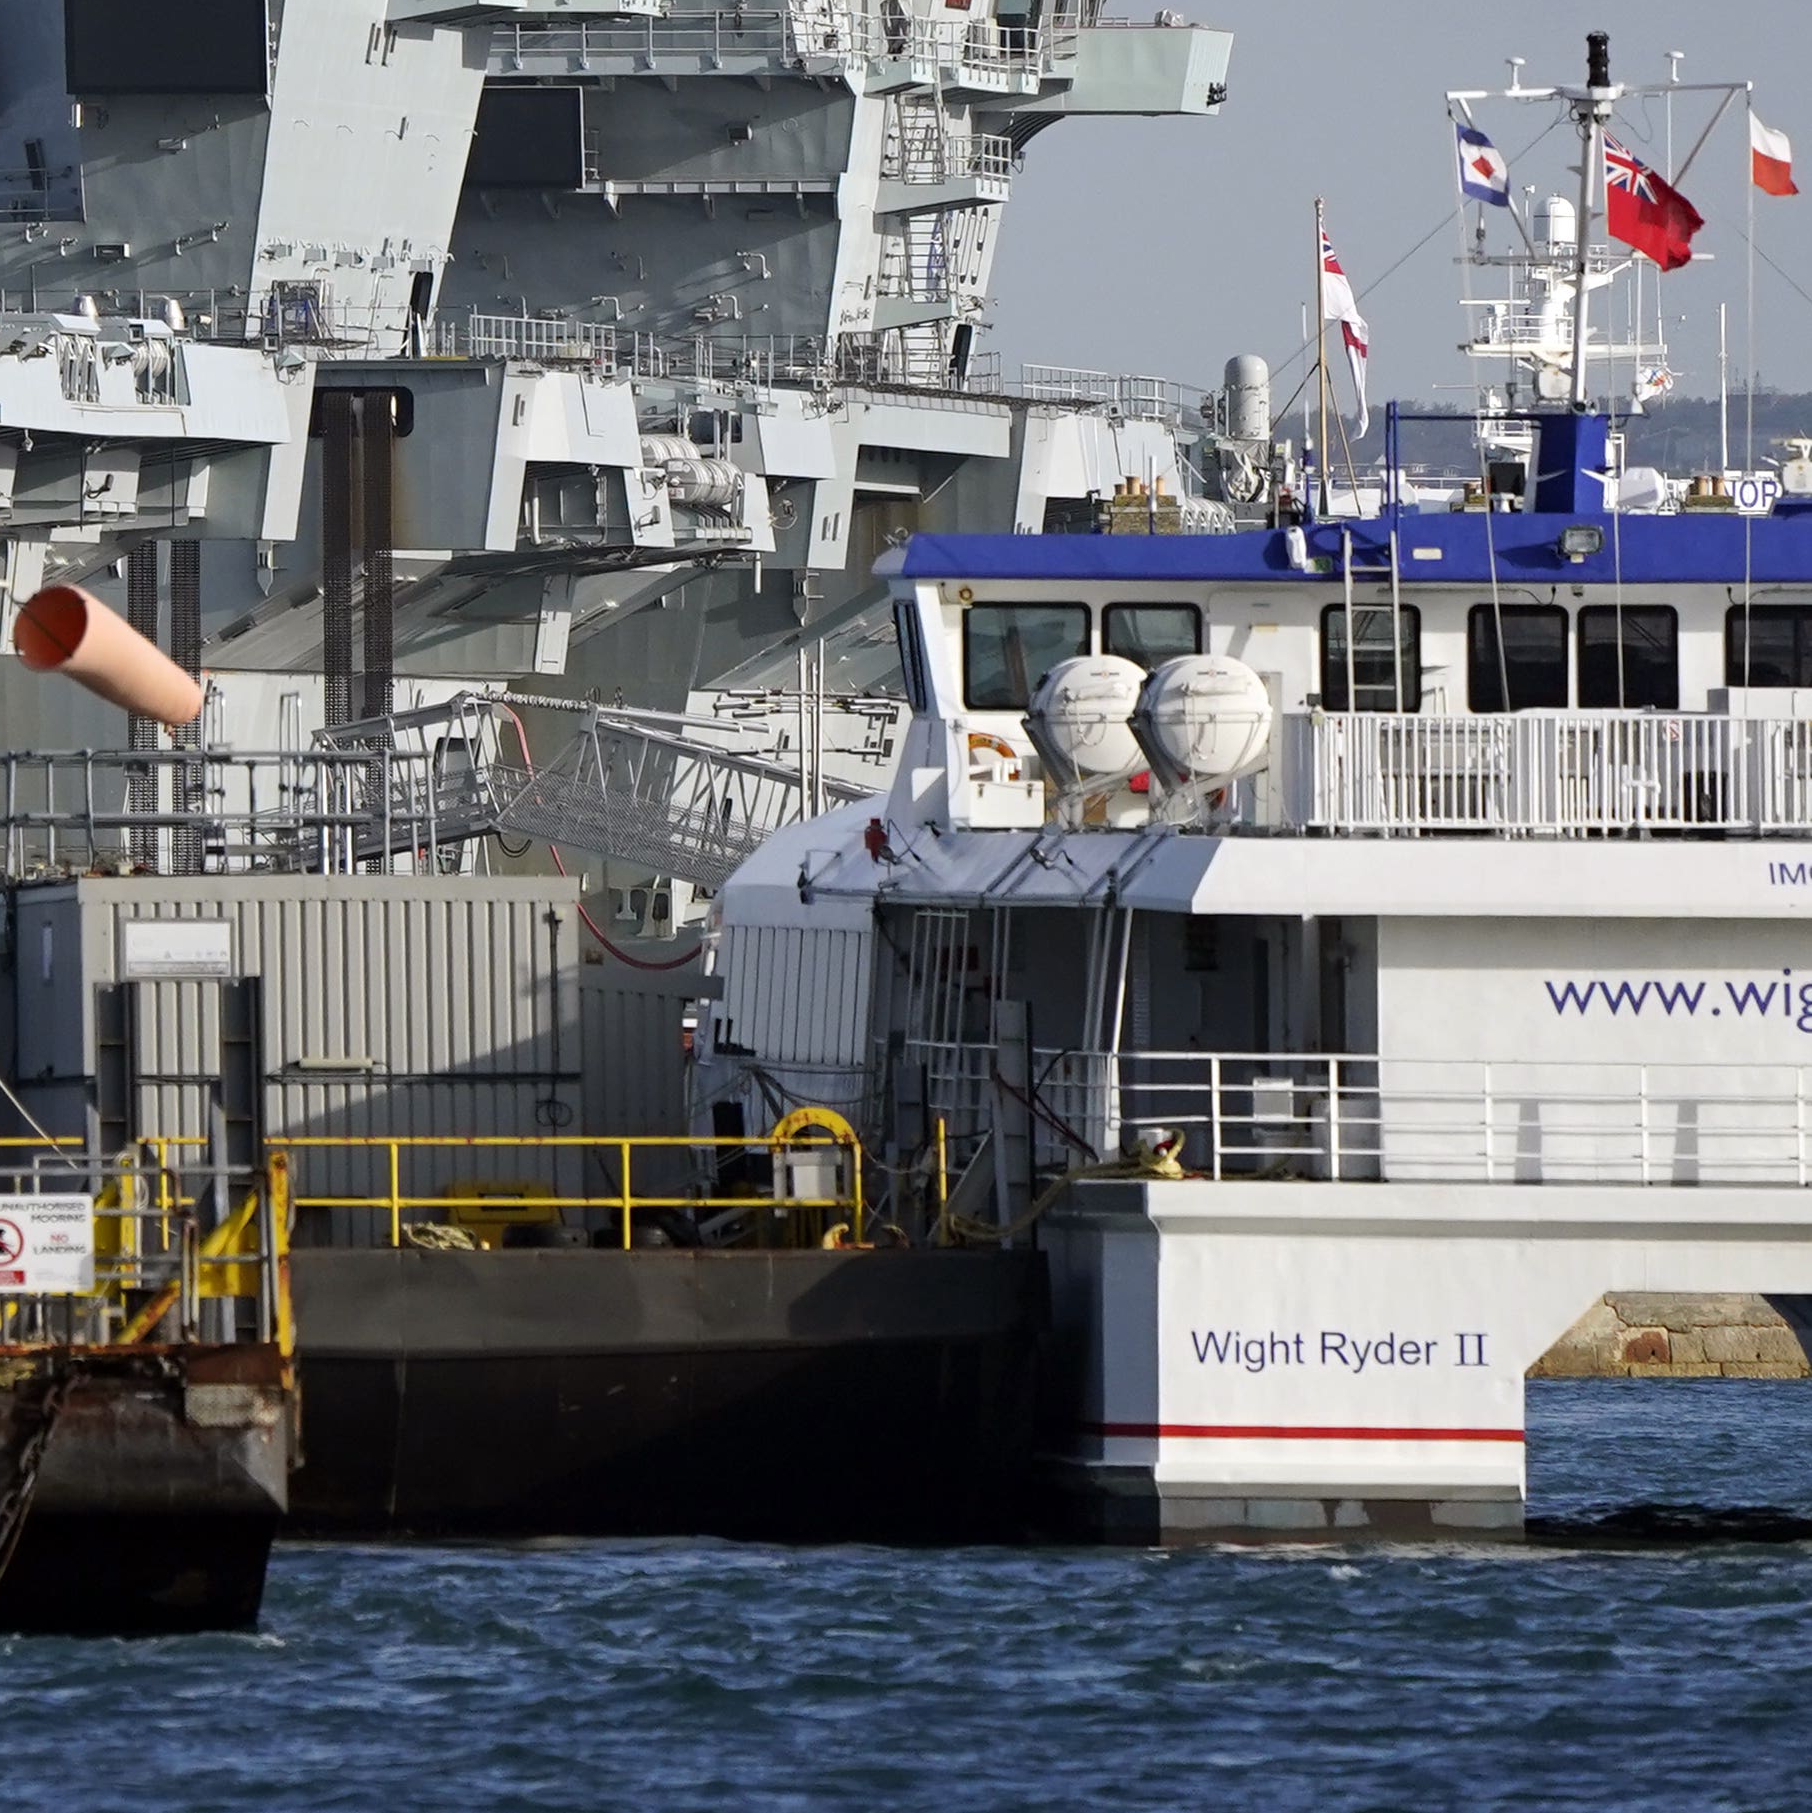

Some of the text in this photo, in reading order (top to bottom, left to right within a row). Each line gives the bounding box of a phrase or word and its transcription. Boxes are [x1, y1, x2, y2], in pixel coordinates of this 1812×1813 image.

[1769, 862, 1812, 885] IM
[31, 1214, 87, 1223] MOORING
[50, 1234, 69, 1243] NO
[33, 1245, 87, 1255] LANDING
[1191, 1331, 1305, 1373] Wight
[1320, 1331, 1438, 1373] Ryder
